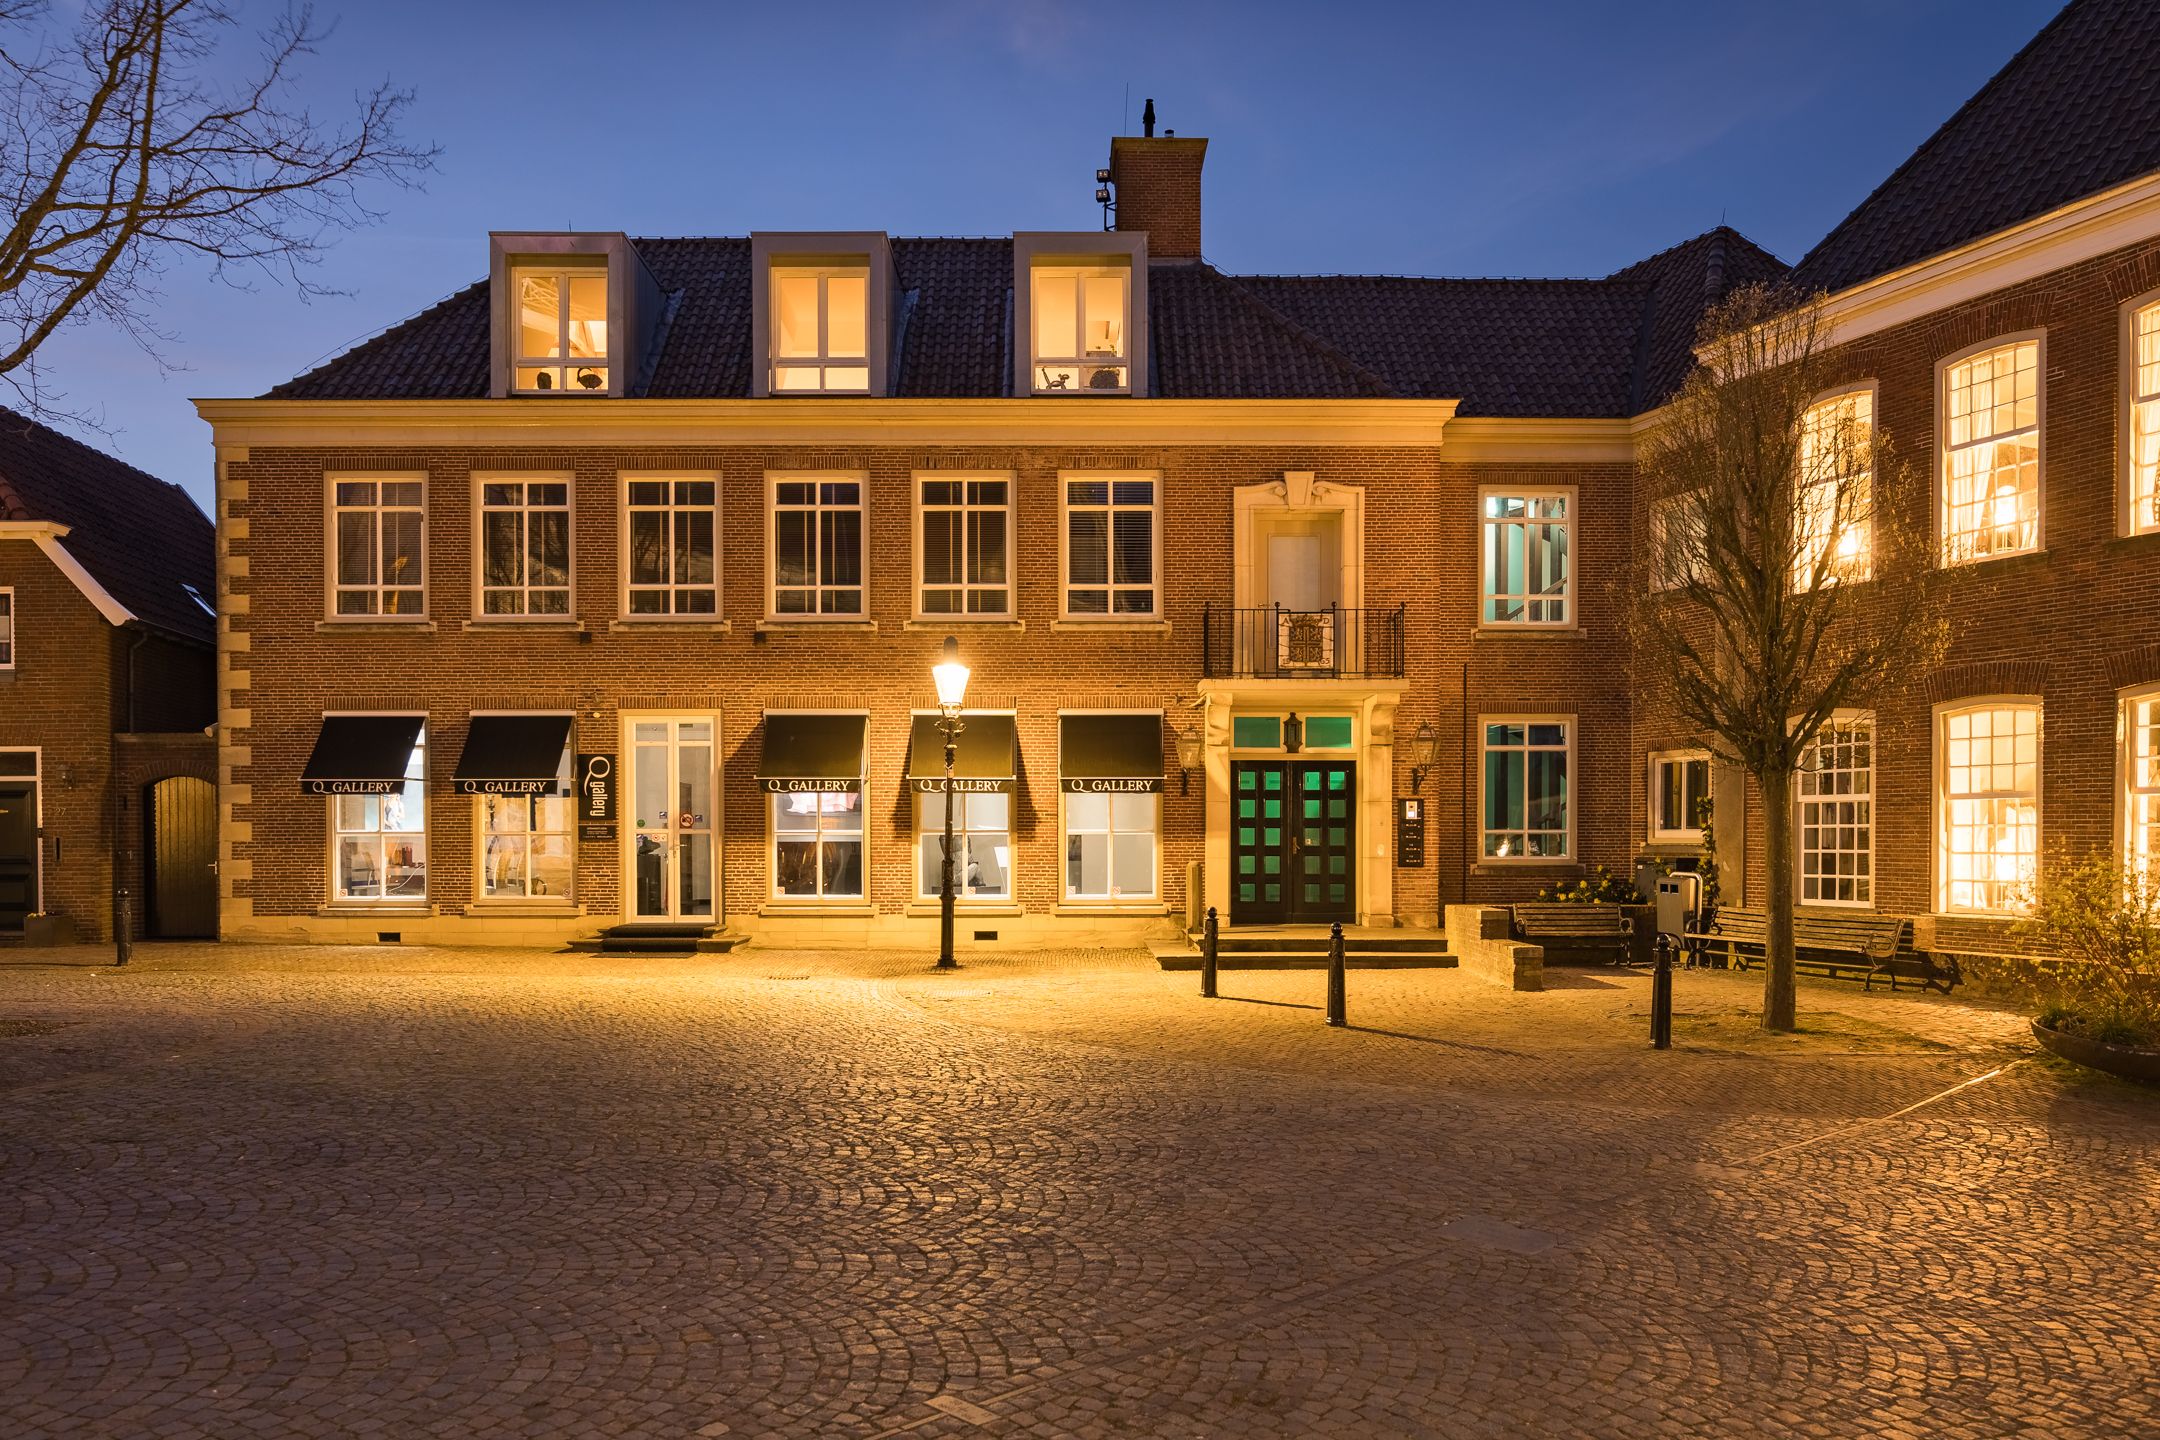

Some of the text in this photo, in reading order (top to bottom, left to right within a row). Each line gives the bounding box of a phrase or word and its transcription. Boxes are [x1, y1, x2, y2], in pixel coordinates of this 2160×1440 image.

[584, 756, 610, 796] Q
[312, 780, 394, 794] Q GALLERY
[464, 780, 547, 794] Q GALLERY
[768, 779, 851, 793] Q GALLERY
[920, 779, 942, 793] Q
[1071, 779, 1154, 793] Q GALLERY
[589, 781, 608, 817] gallery
[54, 807, 67, 816] 27
